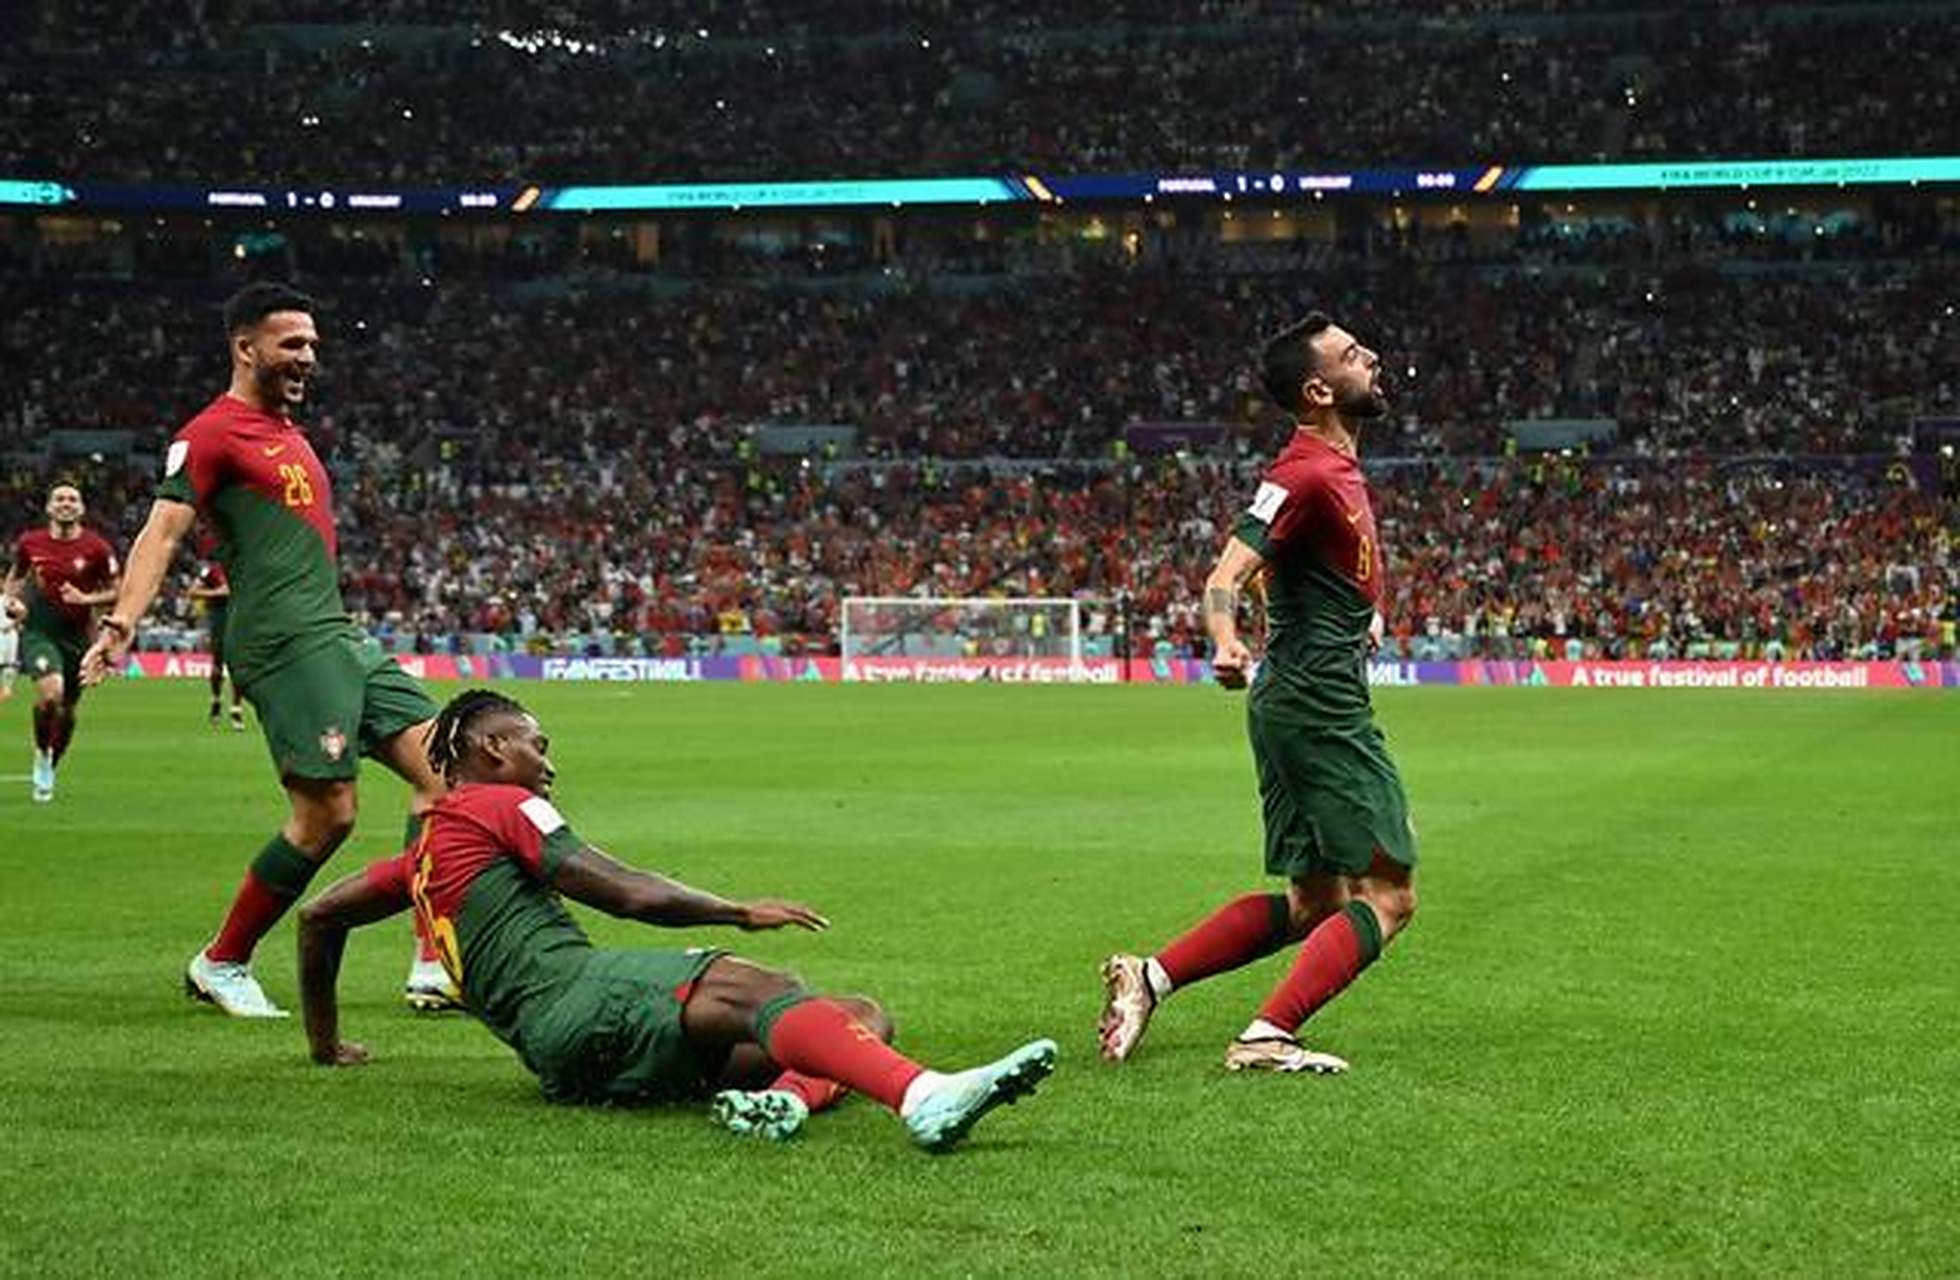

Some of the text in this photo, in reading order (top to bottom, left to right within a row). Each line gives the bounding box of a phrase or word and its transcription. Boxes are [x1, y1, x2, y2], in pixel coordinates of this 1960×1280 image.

[1237, 176, 1247, 192] 1
[1270, 174, 1284, 192] 0
[287, 192, 297, 207] 1
[319, 191, 334, 208] 0
[279, 464, 313, 506] 26
[1572, 666, 1867, 686] A true festival of football
